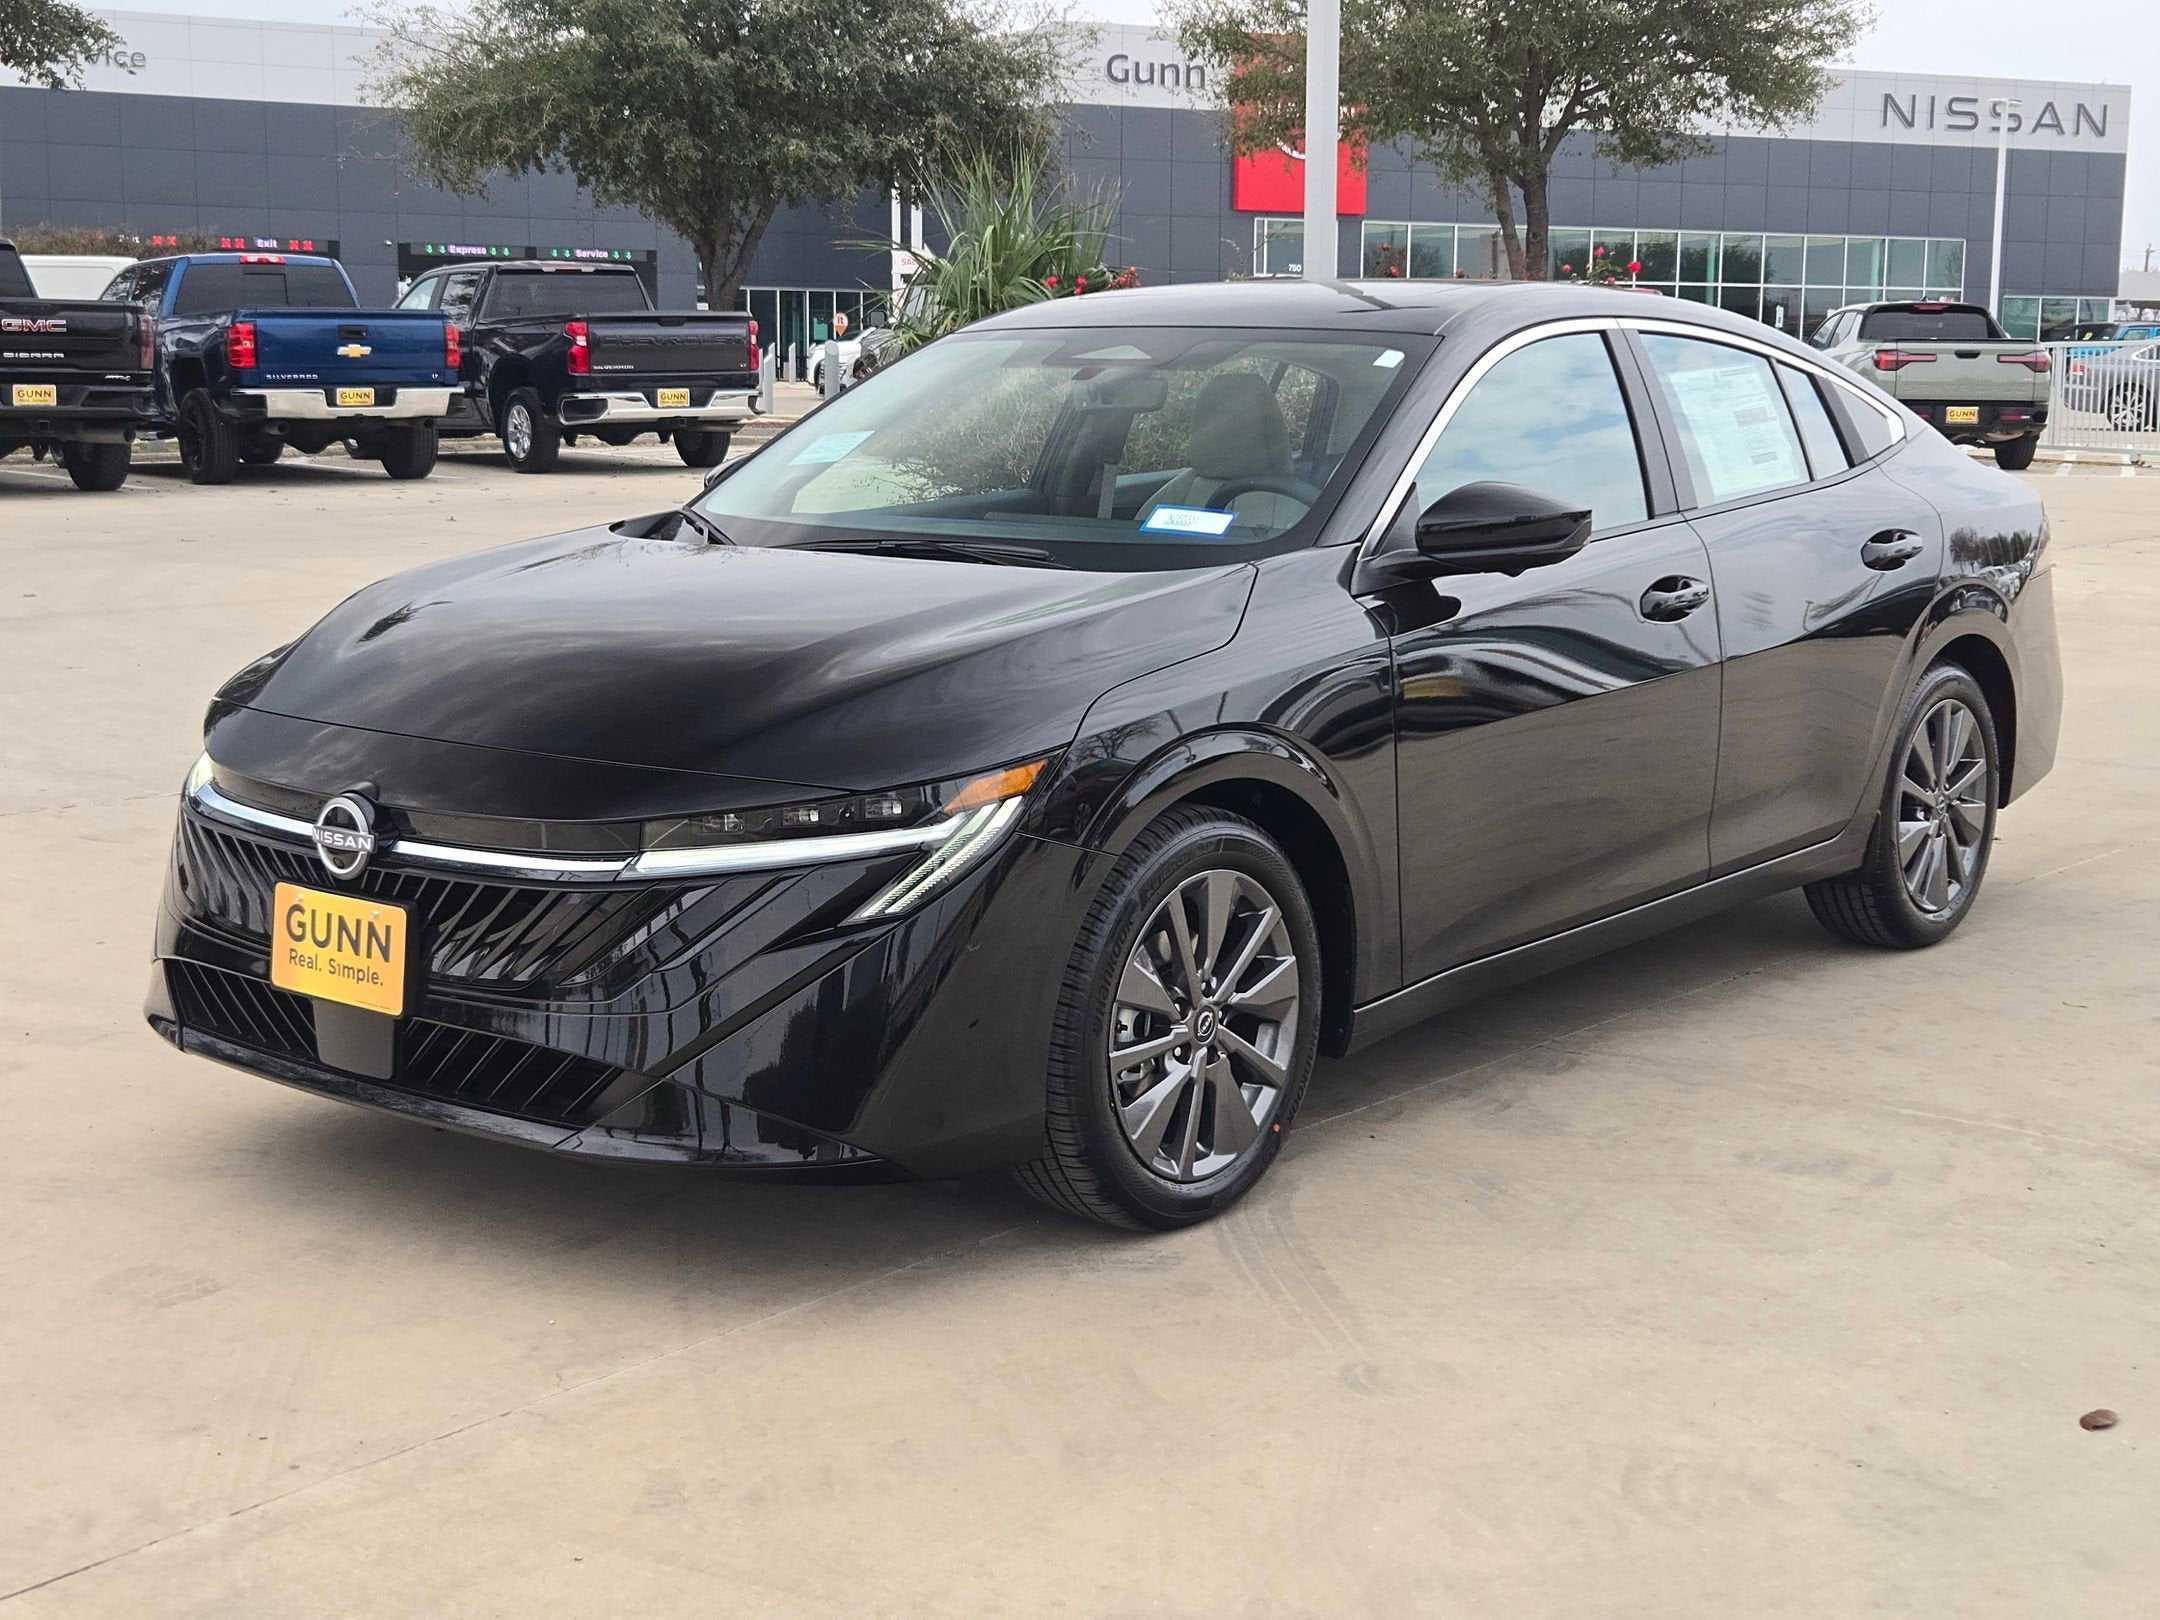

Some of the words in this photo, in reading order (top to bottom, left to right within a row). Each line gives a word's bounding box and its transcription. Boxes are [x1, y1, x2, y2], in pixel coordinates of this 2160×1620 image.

[1106, 54, 1205, 89] Gunn
[1881, 93, 2109, 138] NISSAN
[256, 238, 278, 248] Exit
[449, 244, 487, 256] Express
[575, 249, 609, 258] Service
[1, 318, 67, 332] GMC
[17, 389, 52, 398] GUNN
[340, 391, 370, 399] GUNN
[660, 392, 686, 400] GUNN
[1949, 410, 1976, 418] GUNN
[312, 827, 372, 851] NISSAN
[286, 903, 393, 964] GUNN
[289, 948, 322, 973] Real.
[328, 958, 384, 986] Simple.
